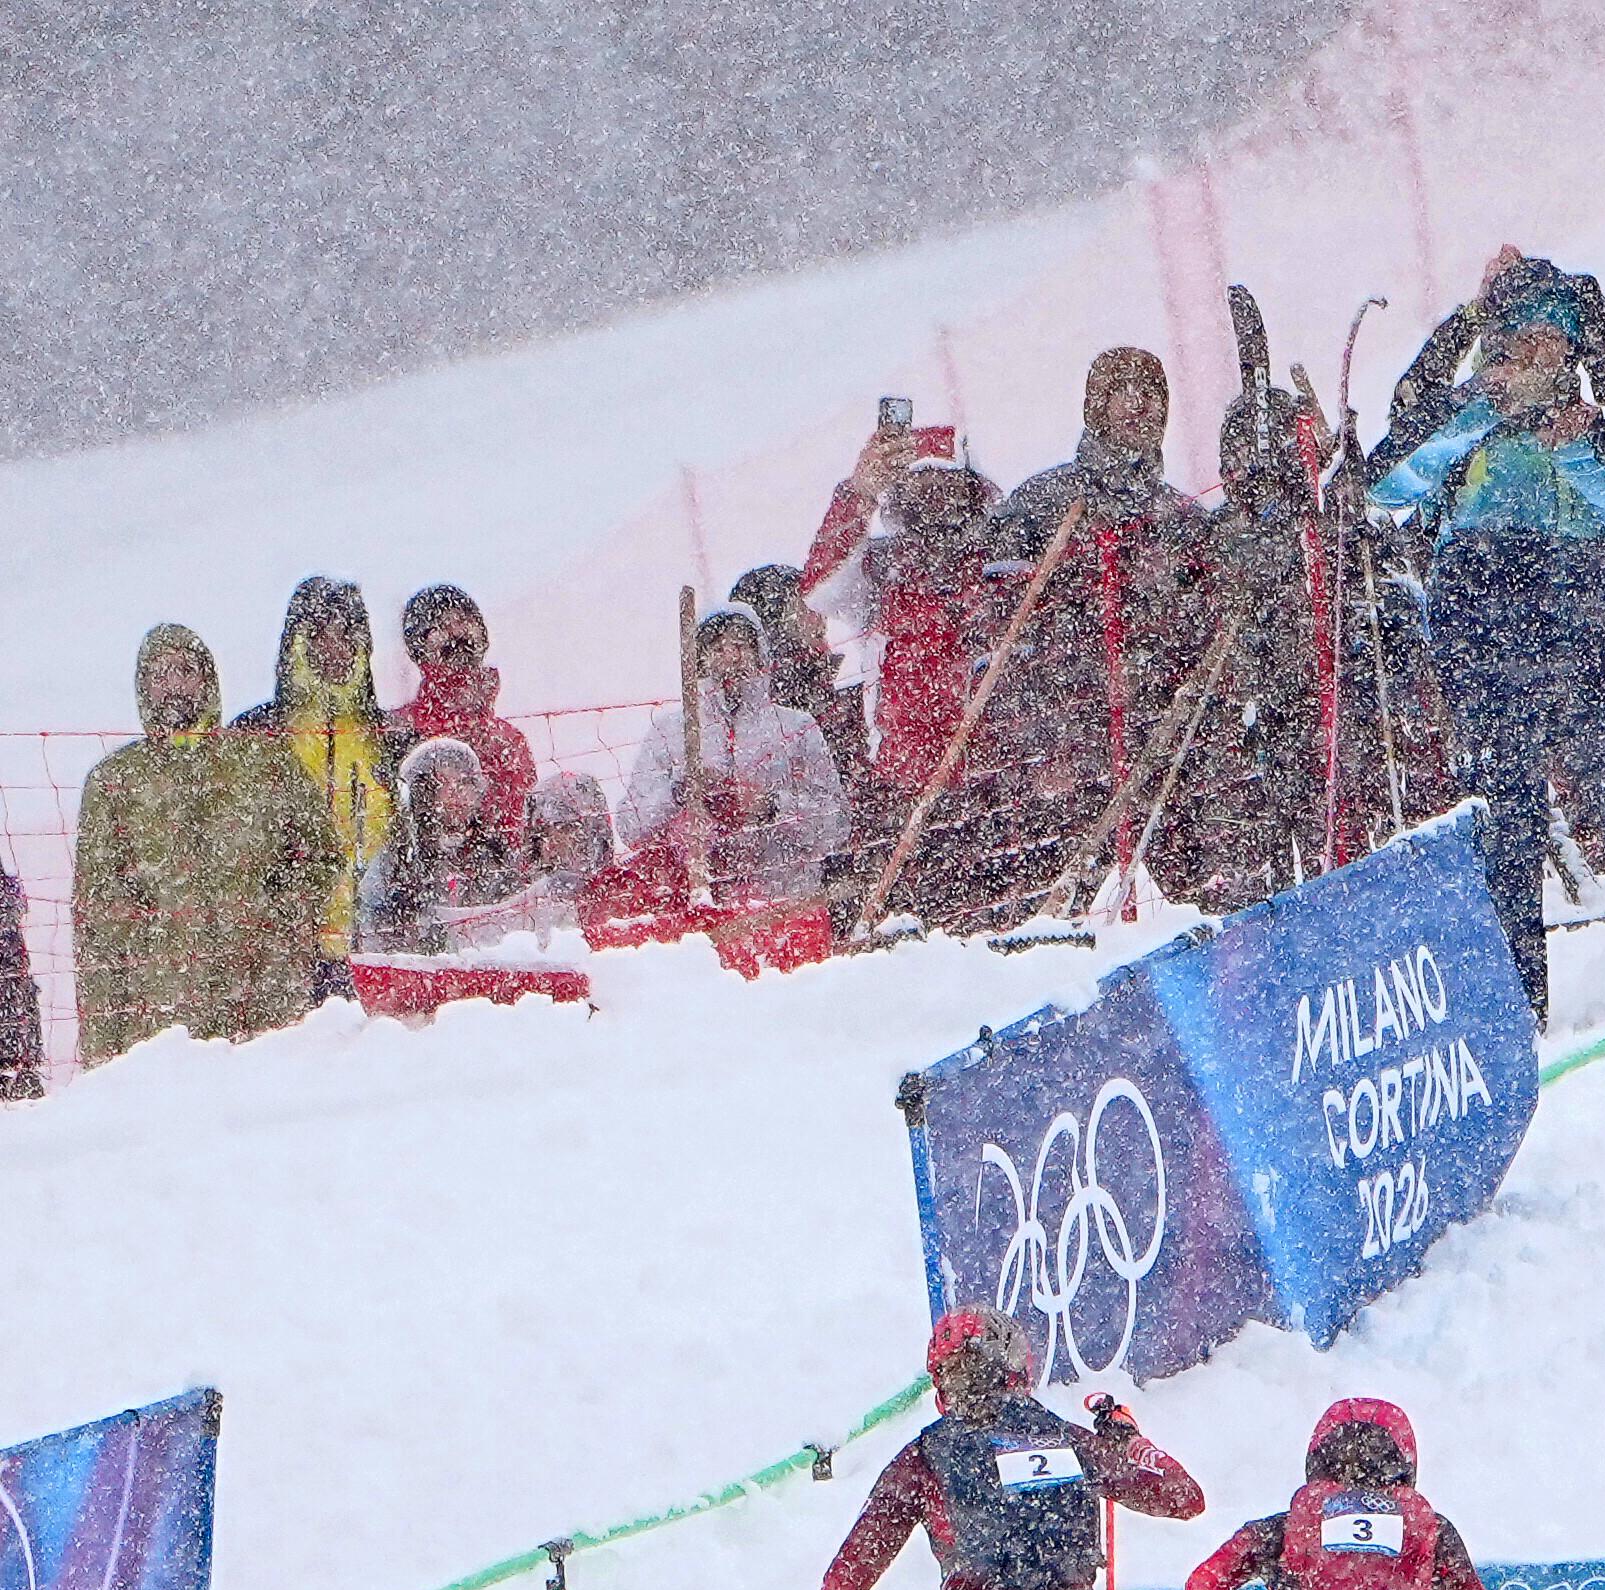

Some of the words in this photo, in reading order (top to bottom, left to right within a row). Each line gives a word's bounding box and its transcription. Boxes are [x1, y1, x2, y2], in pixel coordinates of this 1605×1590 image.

[1292, 944, 1447, 1084] MILANO
[1322, 1037, 1494, 1170] CORTINA
[1360, 1162, 1430, 1262] 2026
[1028, 1454, 1052, 1477] 2
[1352, 1518, 1373, 1541] 3
